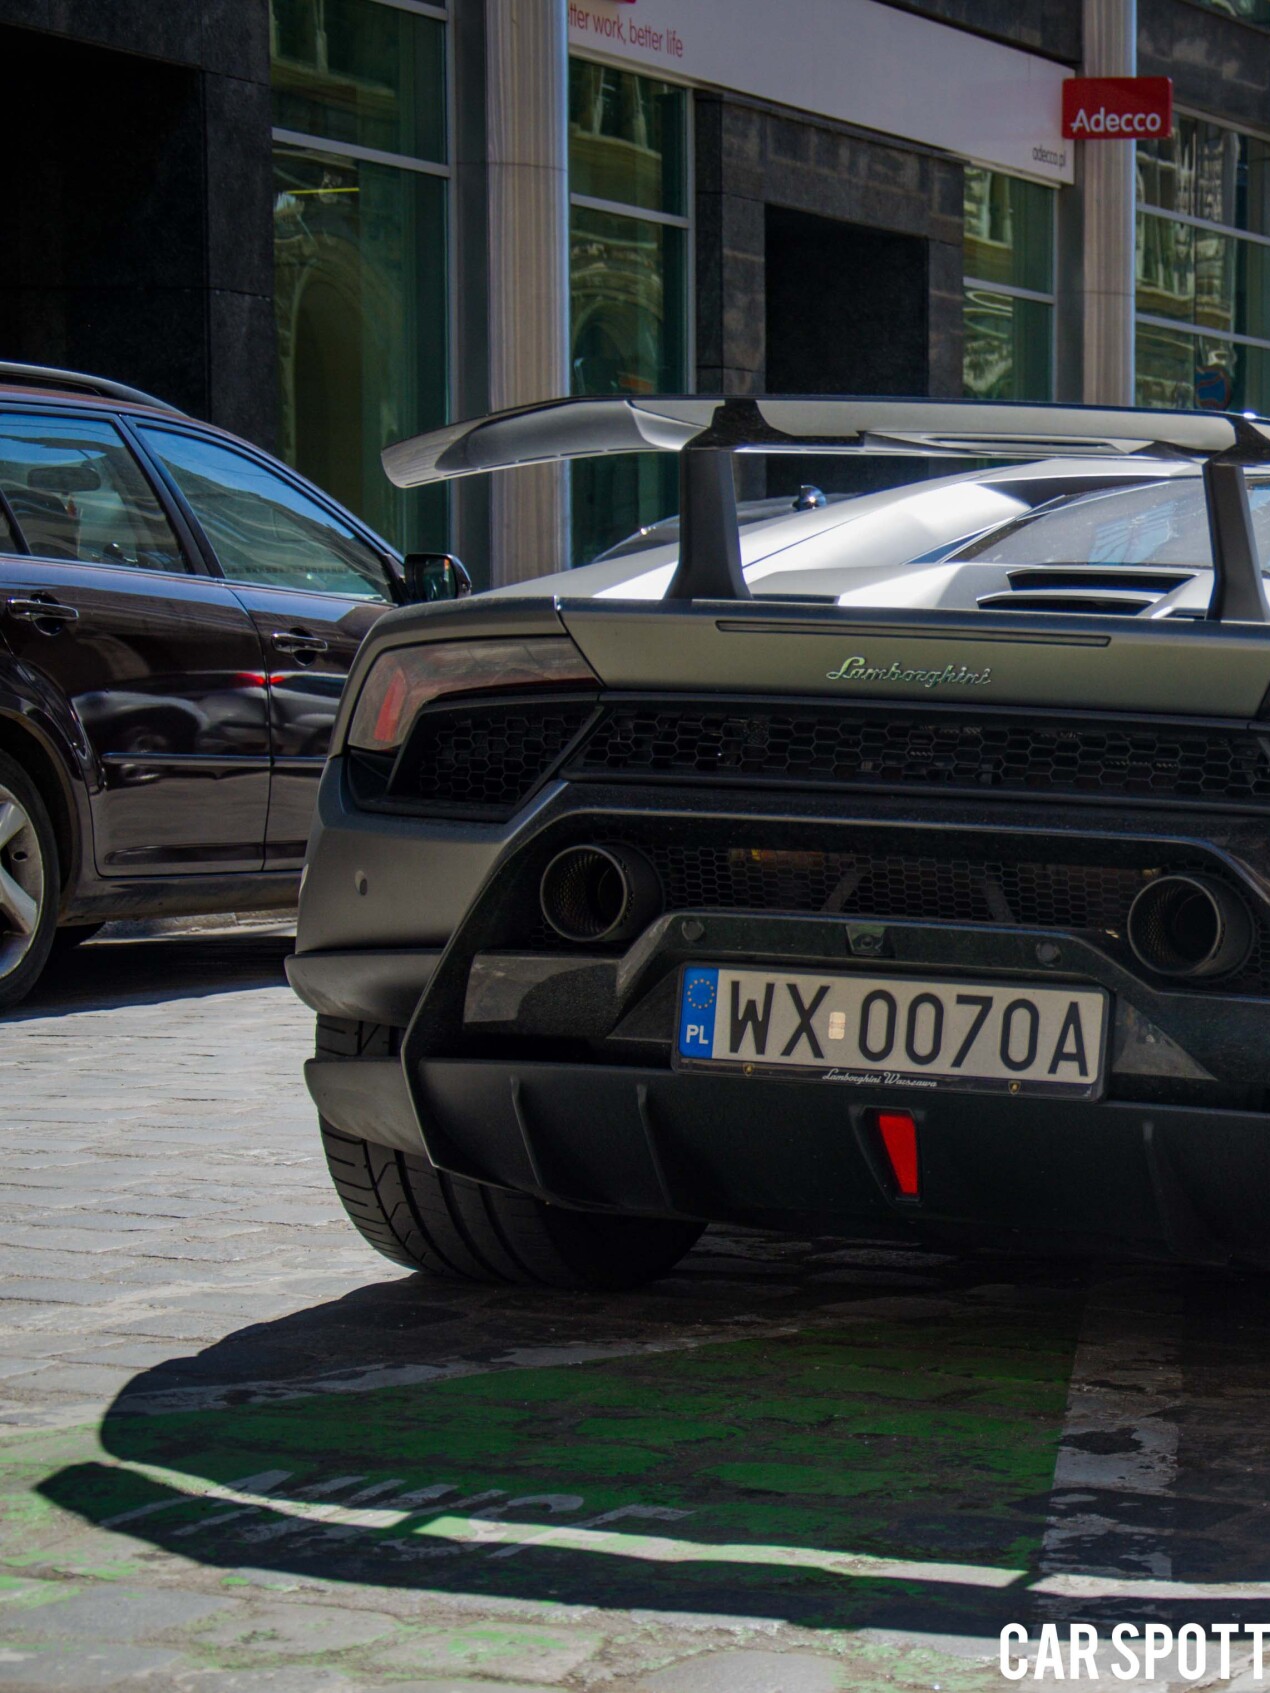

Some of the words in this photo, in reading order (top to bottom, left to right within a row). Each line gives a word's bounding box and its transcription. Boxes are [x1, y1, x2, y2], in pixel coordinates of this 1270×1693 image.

[569, 2, 590, 30] tter
[593, 14, 626, 45] work,
[629, 17, 663, 51] better
[666, 27, 683, 58] life
[1070, 107, 1161, 133] Adecco
[1032, 145, 1067, 170] adecco.pl
[826, 656, 992, 688] Lamborghini
[686, 1025, 709, 1046] PL
[730, 980, 830, 1059] WX
[858, 989, 1089, 1077] 0070A
[822, 1068, 881, 1084] Lamborghini
[883, 1071, 938, 1088] Warszawa
